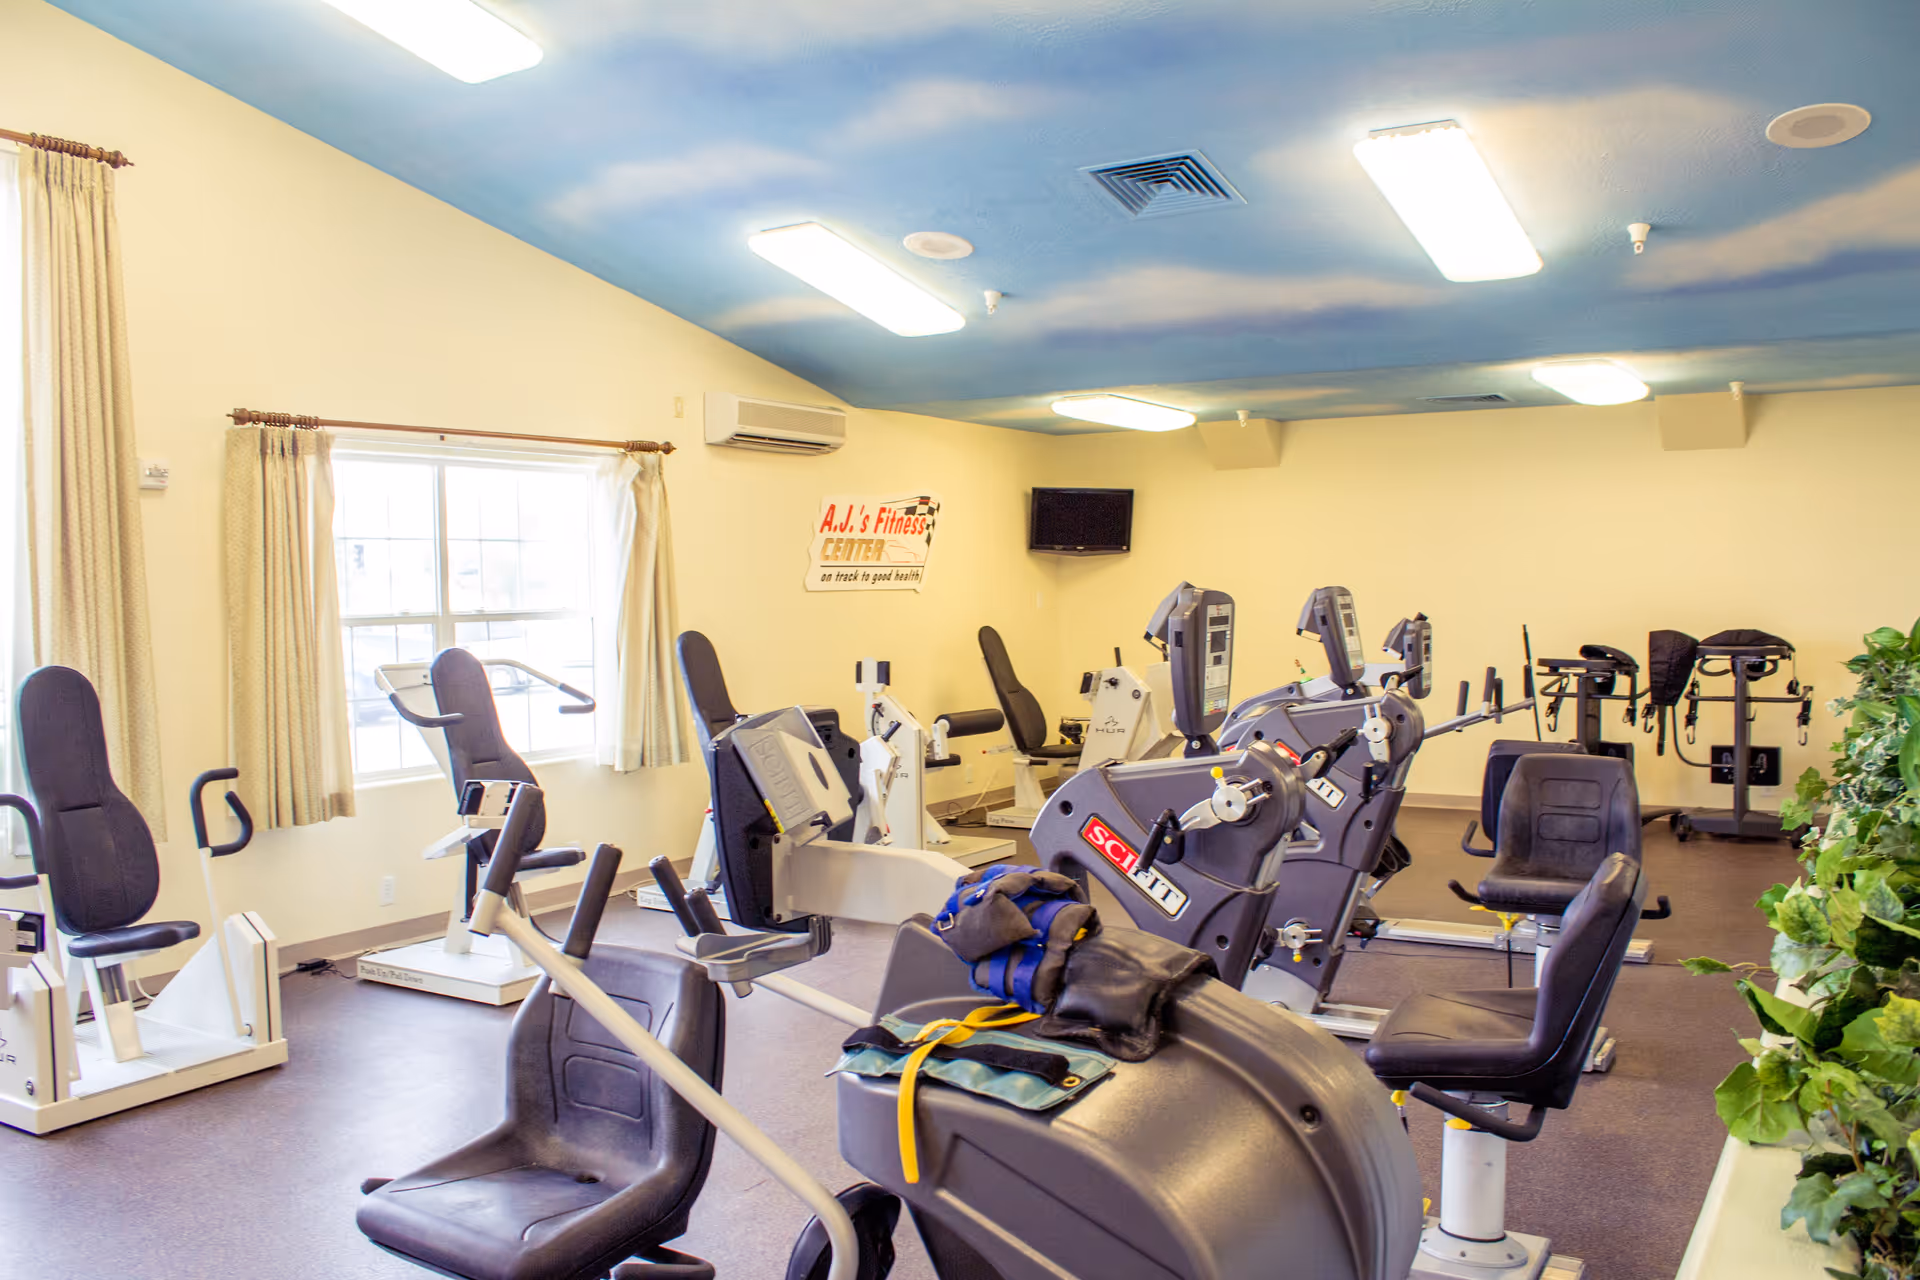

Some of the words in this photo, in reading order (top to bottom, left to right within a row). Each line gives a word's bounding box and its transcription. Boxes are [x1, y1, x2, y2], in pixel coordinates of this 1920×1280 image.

[873, 506, 927, 535] Fitness
[820, 537, 885, 561] CENTER
[820, 572, 832, 582] on
[835, 569, 858, 582] track
[861, 570, 870, 582] to
[871, 569, 893, 584] good
[893, 569, 920, 581] health
